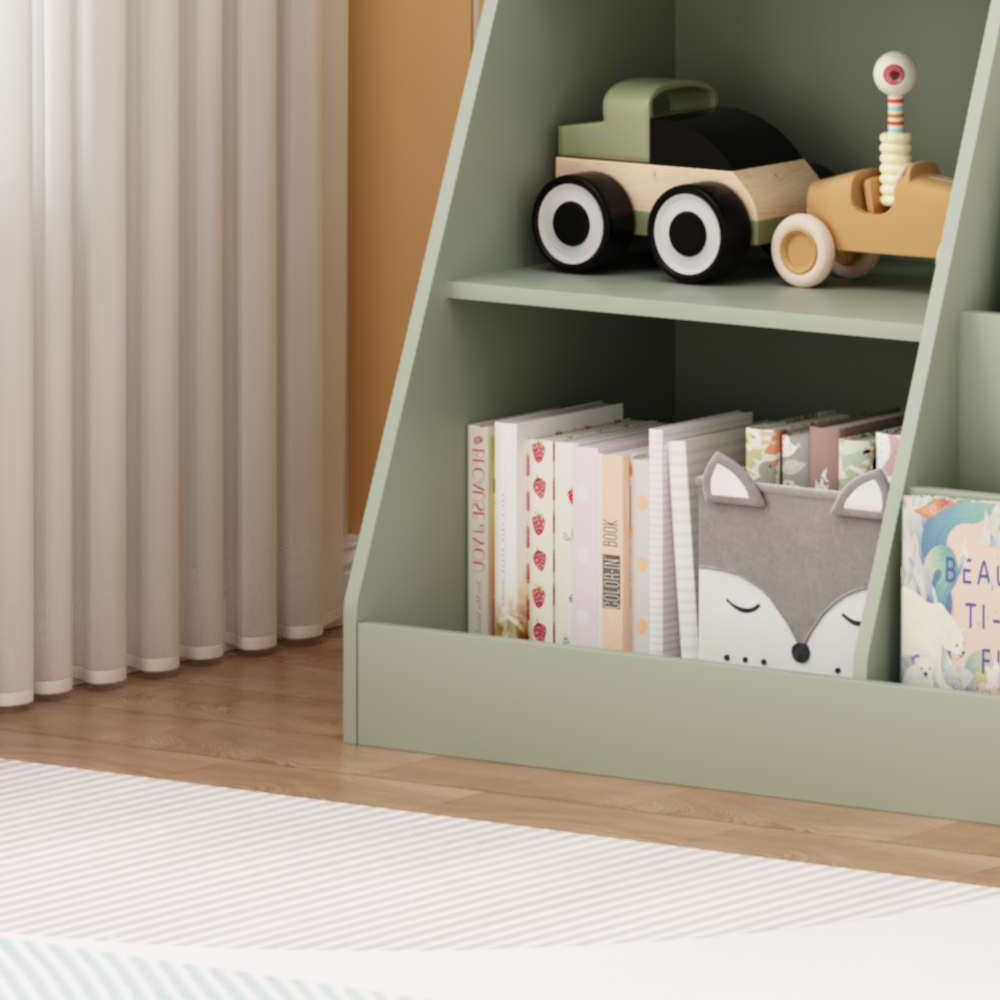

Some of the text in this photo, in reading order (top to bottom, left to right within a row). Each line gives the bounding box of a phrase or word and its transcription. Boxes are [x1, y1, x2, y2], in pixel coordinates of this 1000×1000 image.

[603, 519, 620, 609] COLOR-IN BOOK
[965, 602, 1000, 630] TI-
